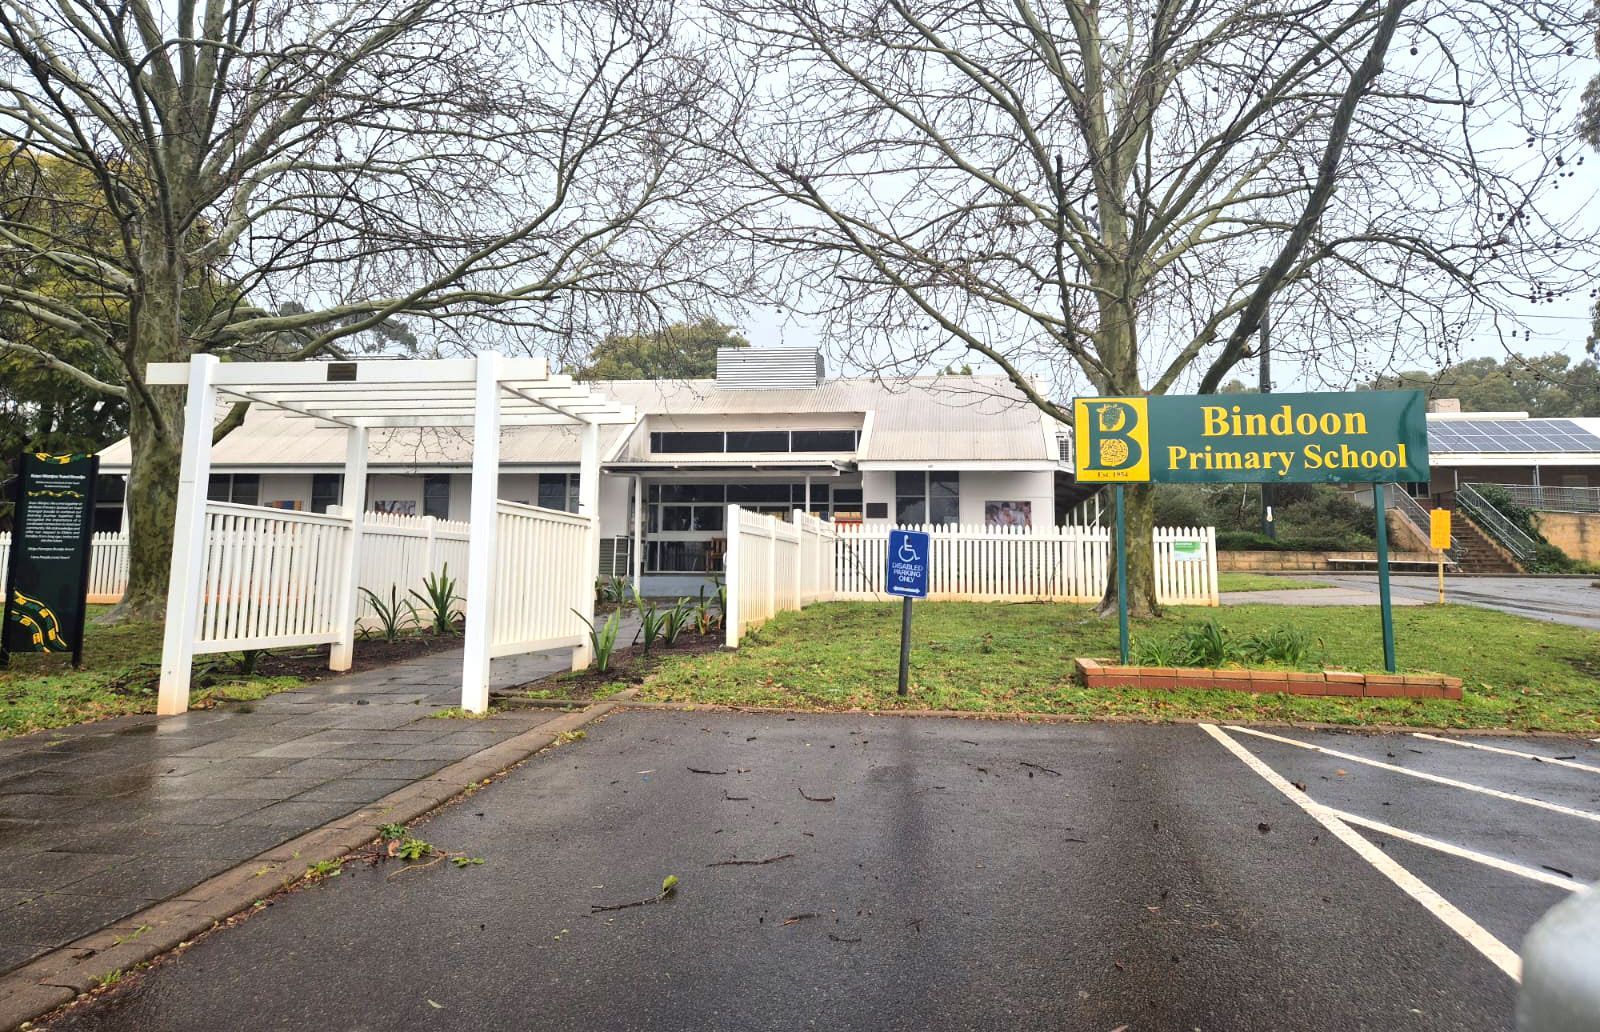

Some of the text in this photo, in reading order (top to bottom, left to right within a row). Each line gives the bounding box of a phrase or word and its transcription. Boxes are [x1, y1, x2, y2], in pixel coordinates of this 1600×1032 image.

[1200, 405, 1369, 437] Bindoon
[1167, 444, 1408, 476] Primary School
[892, 562, 924, 572] DISABLED
[893, 569, 921, 578] PARKING
[898, 575, 915, 583] ONLY
